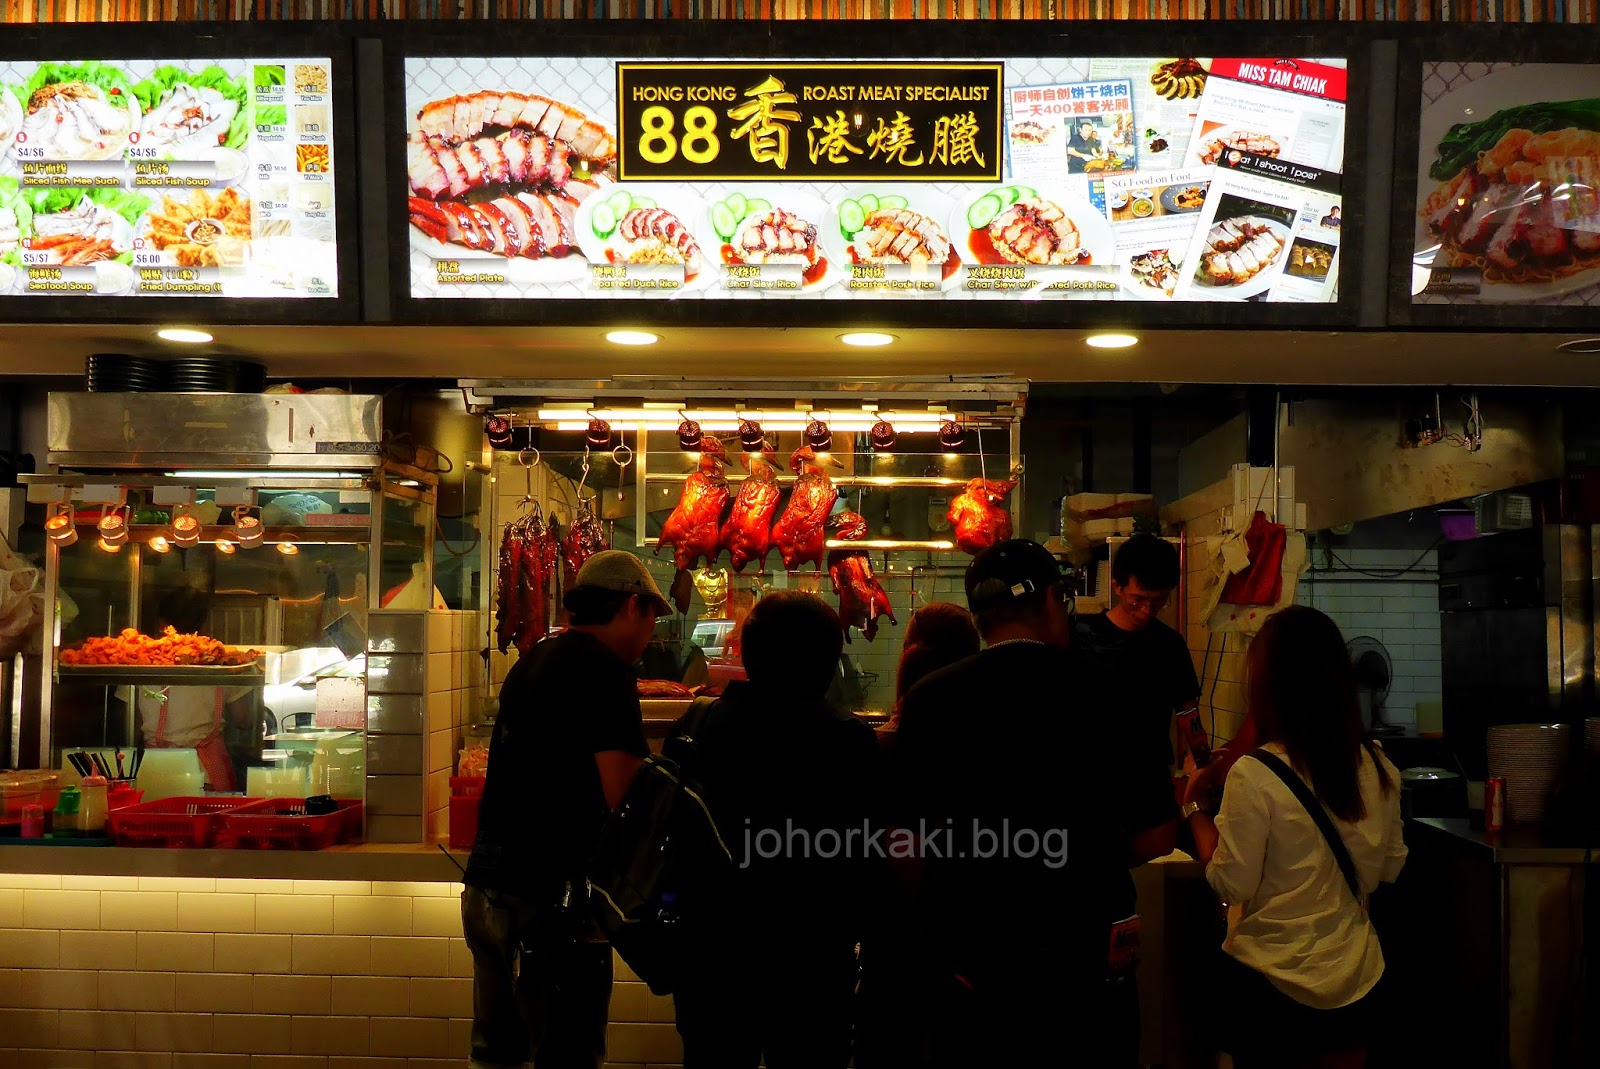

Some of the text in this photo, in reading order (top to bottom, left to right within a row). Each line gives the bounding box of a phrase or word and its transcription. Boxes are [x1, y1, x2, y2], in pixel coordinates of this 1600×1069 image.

[1238, 62, 1266, 82] MISS
[1268, 69, 1292, 88] TAM
[1293, 74, 1327, 95] CHIAK
[633, 86, 737, 102] HONG KONG
[804, 86, 989, 101] ROAST MEAT SPECIALIST
[638, 105, 721, 164] 88
[18, 147, 44, 157] $4/$6
[130, 147, 157, 157] $4/$6
[23, 177, 120, 185] Sliced Fish Mee Suah
[136, 177, 210, 186] Sliced Fish Soup
[1111, 179, 1126, 188] SG
[1130, 176, 1153, 187] Food
[1171, 173, 1191, 182] Foot
[24, 253, 49, 263] $5/$7
[136, 254, 160, 263] $6.00
[437, 274, 505, 282] Assorted Plate
[29, 281, 93, 291] Seafood Soup
[140, 283, 163, 291] Fried
[166, 283, 211, 292] Dumpling
[592, 279, 679, 288] Roasted Duck Rice
[726, 279, 796, 288] Char Siew Rice
[850, 280, 935, 288] Roasted Pork Rice
[967, 280, 1116, 289] Char Siew w/Rsted Pork Rice
